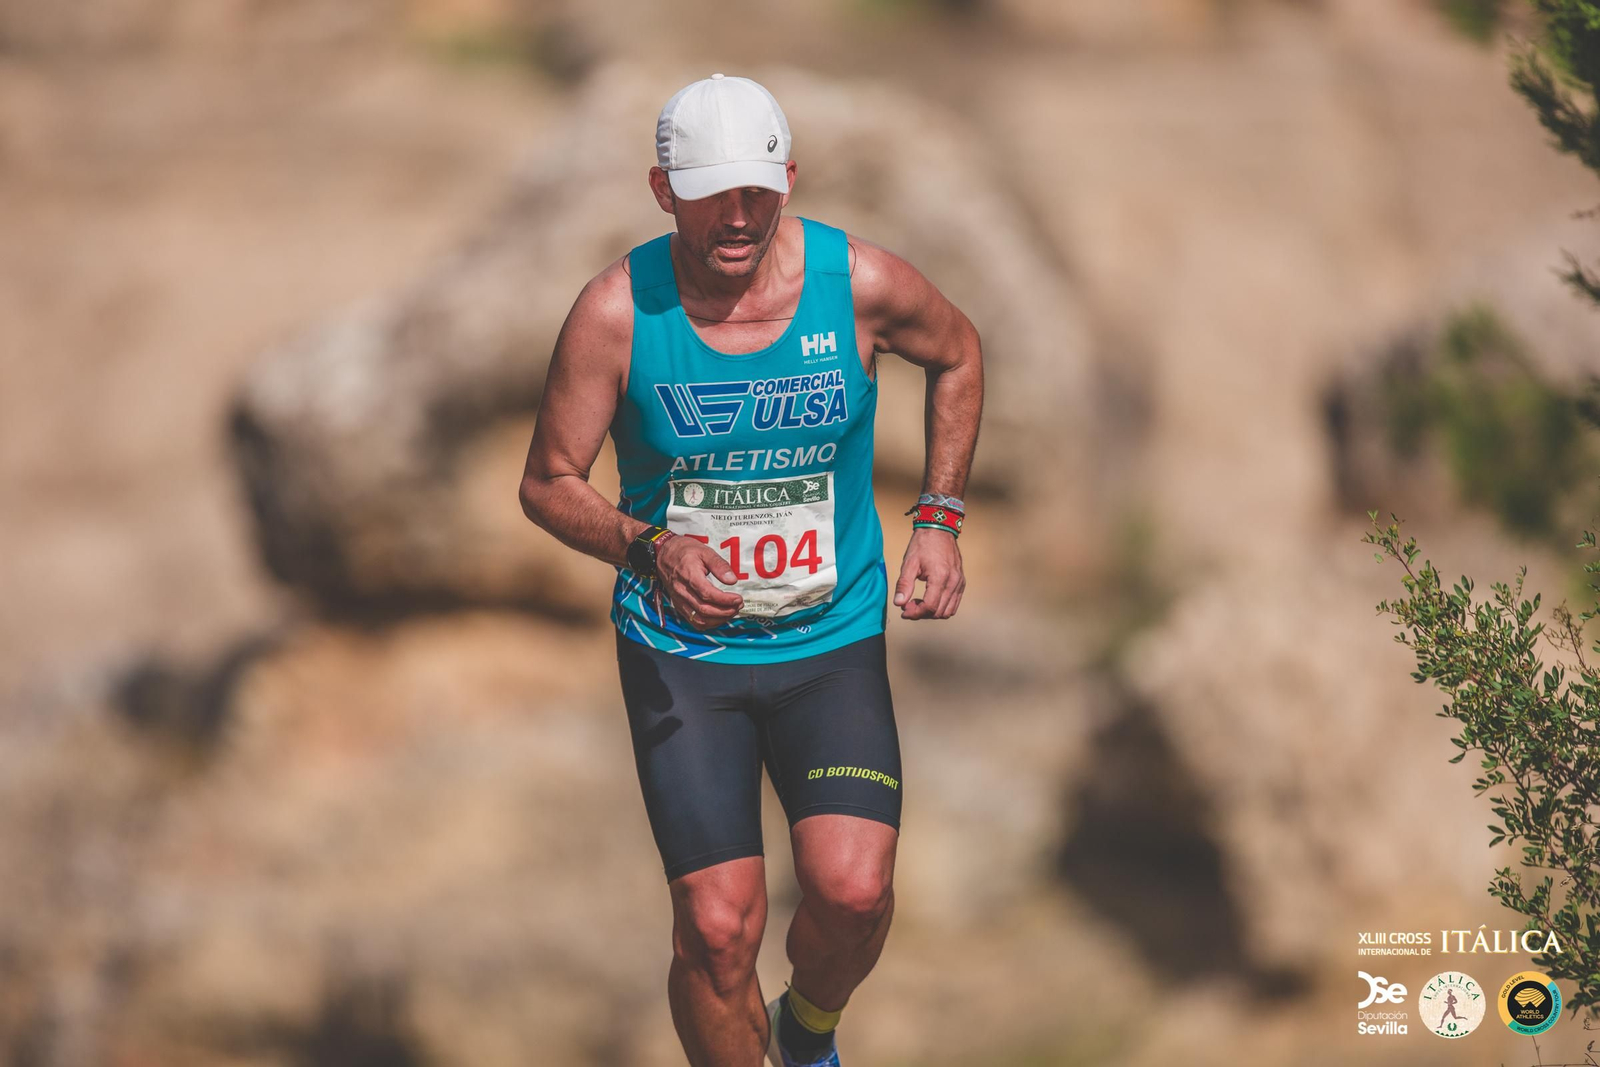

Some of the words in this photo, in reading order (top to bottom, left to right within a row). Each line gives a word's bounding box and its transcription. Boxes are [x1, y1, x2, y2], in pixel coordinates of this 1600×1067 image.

[800, 331, 837, 357] HH
[751, 369, 845, 398] COMERCIAL
[752, 387, 848, 431] ULSA
[670, 442, 838, 473] ATLETISMO
[713, 486, 791, 505] ITÁLICA
[776, 510, 793, 519] IVÁN
[683, 529, 823, 581] 104
[807, 768, 824, 780] CD
[826, 766, 899, 790] BOTIJOSPORT
